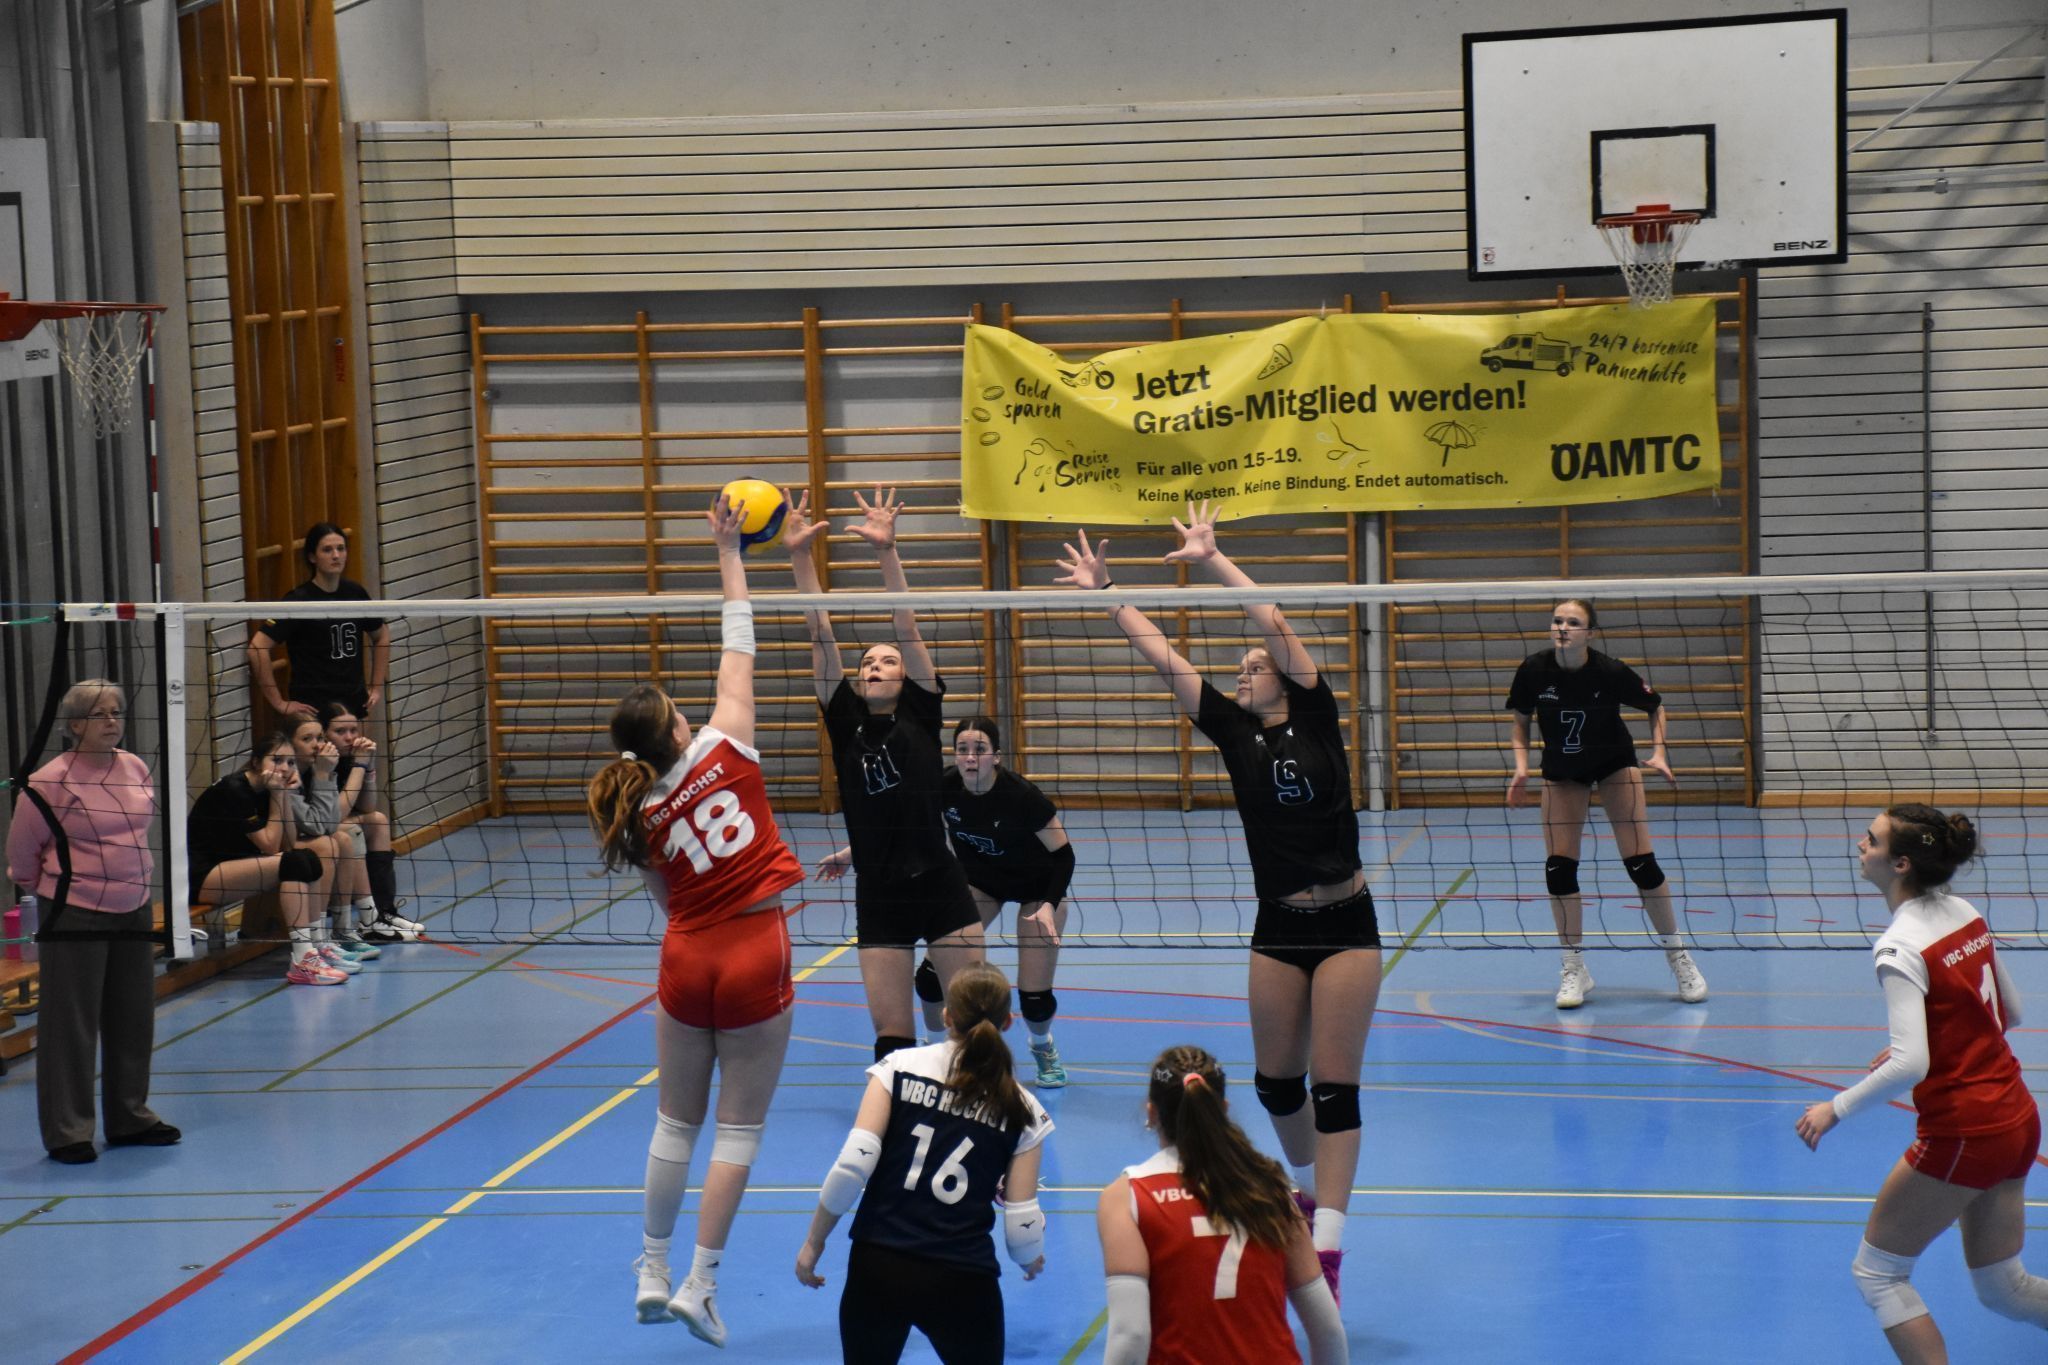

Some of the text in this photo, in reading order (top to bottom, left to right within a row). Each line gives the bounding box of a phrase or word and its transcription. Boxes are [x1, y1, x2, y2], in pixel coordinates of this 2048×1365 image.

[1774, 240, 1828, 251] BENZ
[1589, 332, 1628, 352] 24/7
[1132, 364, 1211, 400] Jetzt
[1585, 352, 1687, 384] Pannenhilfe
[1015, 377, 1051, 400] Geld
[1003, 402, 1062, 425] sparen
[1133, 380, 1526, 434] Gratis-Mitglied werden!
[1073, 450, 1109, 469] Reise
[1136, 461, 1165, 476] Für
[1171, 461, 1203, 476] alle
[1208, 457, 1238, 474] von
[1551, 433, 1701, 482] ÖAMTC
[1055, 460, 1121, 487] Service
[1138, 471, 1509, 502] Keine Kosten. Keine Bindung. Endet automatisch.
[330, 622, 358, 660] 16
[1561, 710, 1586, 746] 7
[662, 789, 756, 875] 18
[1942, 949, 1964, 968] VBC
[900, 1077, 938, 1108] VBC
[903, 1122, 975, 1206] 16
[1190, 1215, 1249, 1300] 7
